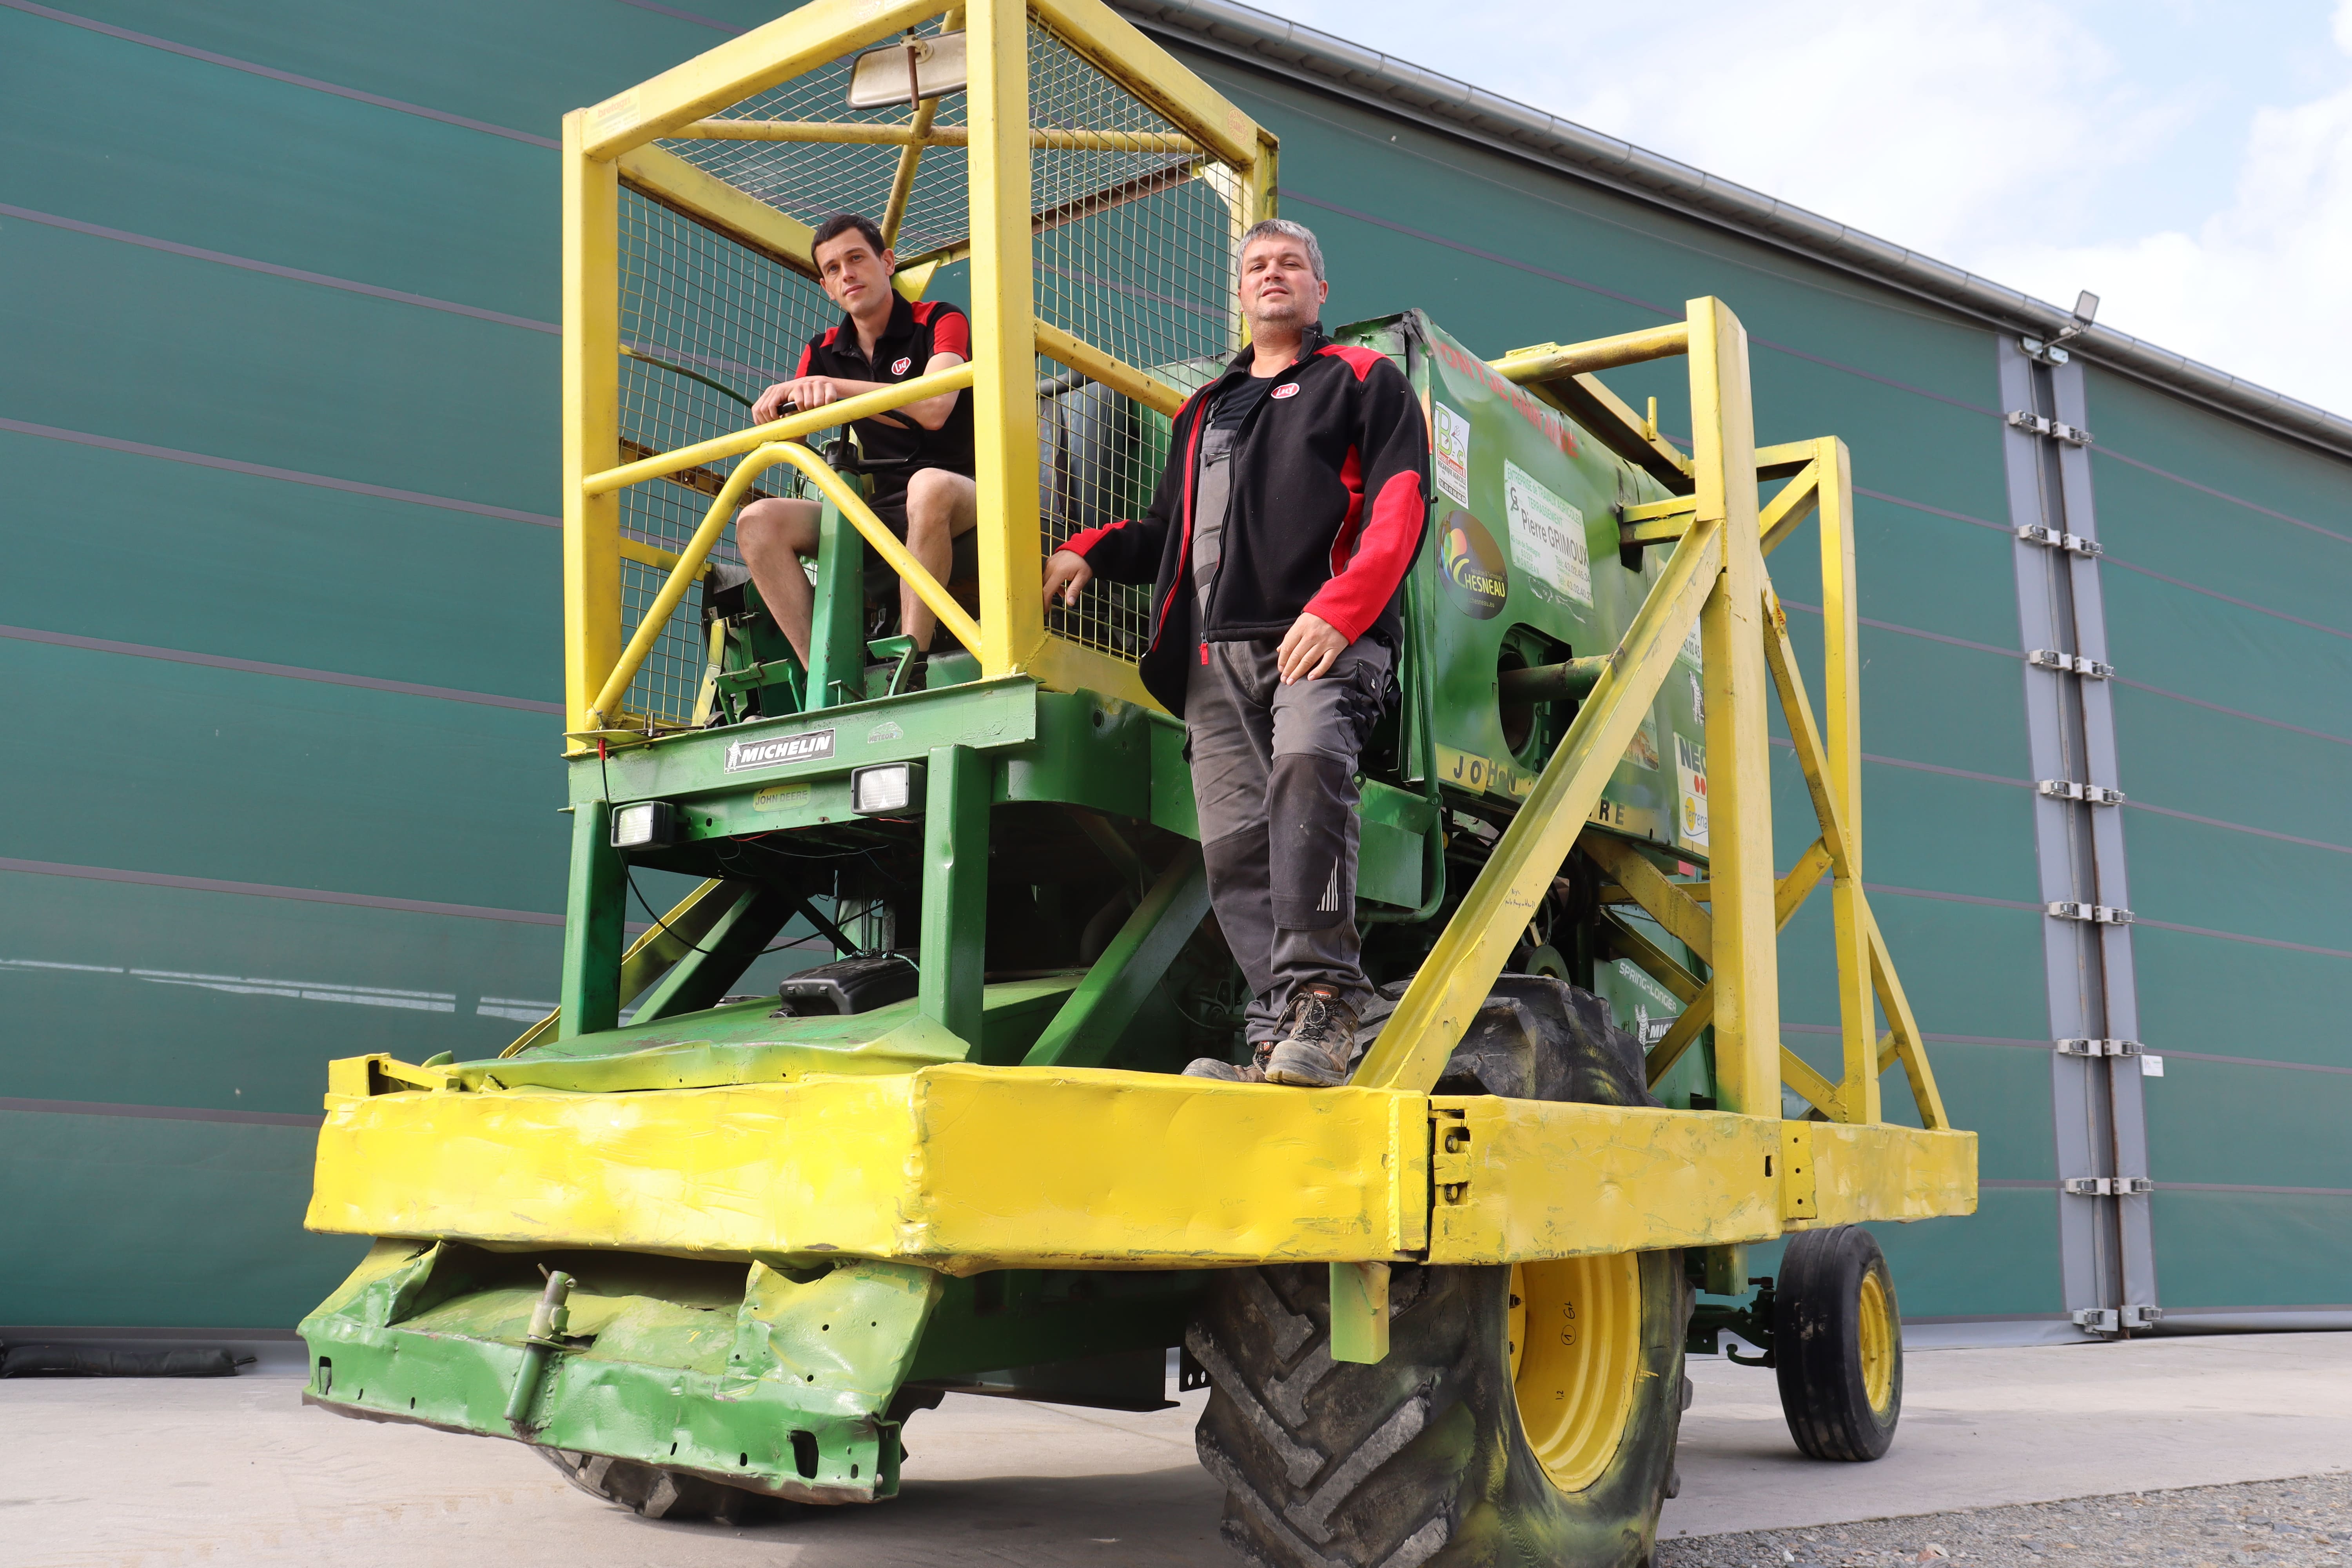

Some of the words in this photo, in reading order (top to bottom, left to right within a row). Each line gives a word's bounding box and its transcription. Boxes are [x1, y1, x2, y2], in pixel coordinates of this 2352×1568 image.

[1508, 467, 1532, 492] ENTREPRISE
[1532, 484, 1538, 495] de
[1538, 486, 1557, 508] TRAVAUX
[1557, 501, 1582, 526] AGRICOLES
[1528, 496, 1563, 527] TERRASSEMENT
[1521, 508, 1547, 543] Pierre
[1548, 526, 1590, 568] GRIMOUX
[1453, 558, 1505, 597] CHESNEAU
[1517, 555, 1539, 575] MONTJEAN
[1689, 640, 1694, 655] 02
[1695, 644, 1700, 659] 45
[740, 735, 831, 763] MICHELIN
[756, 794, 778, 805] JOHN
[780, 790, 808, 802] DEERE
[1684, 805, 1708, 829] Terrena
[1619, 962, 1677, 1014] SPRING-LONGER
